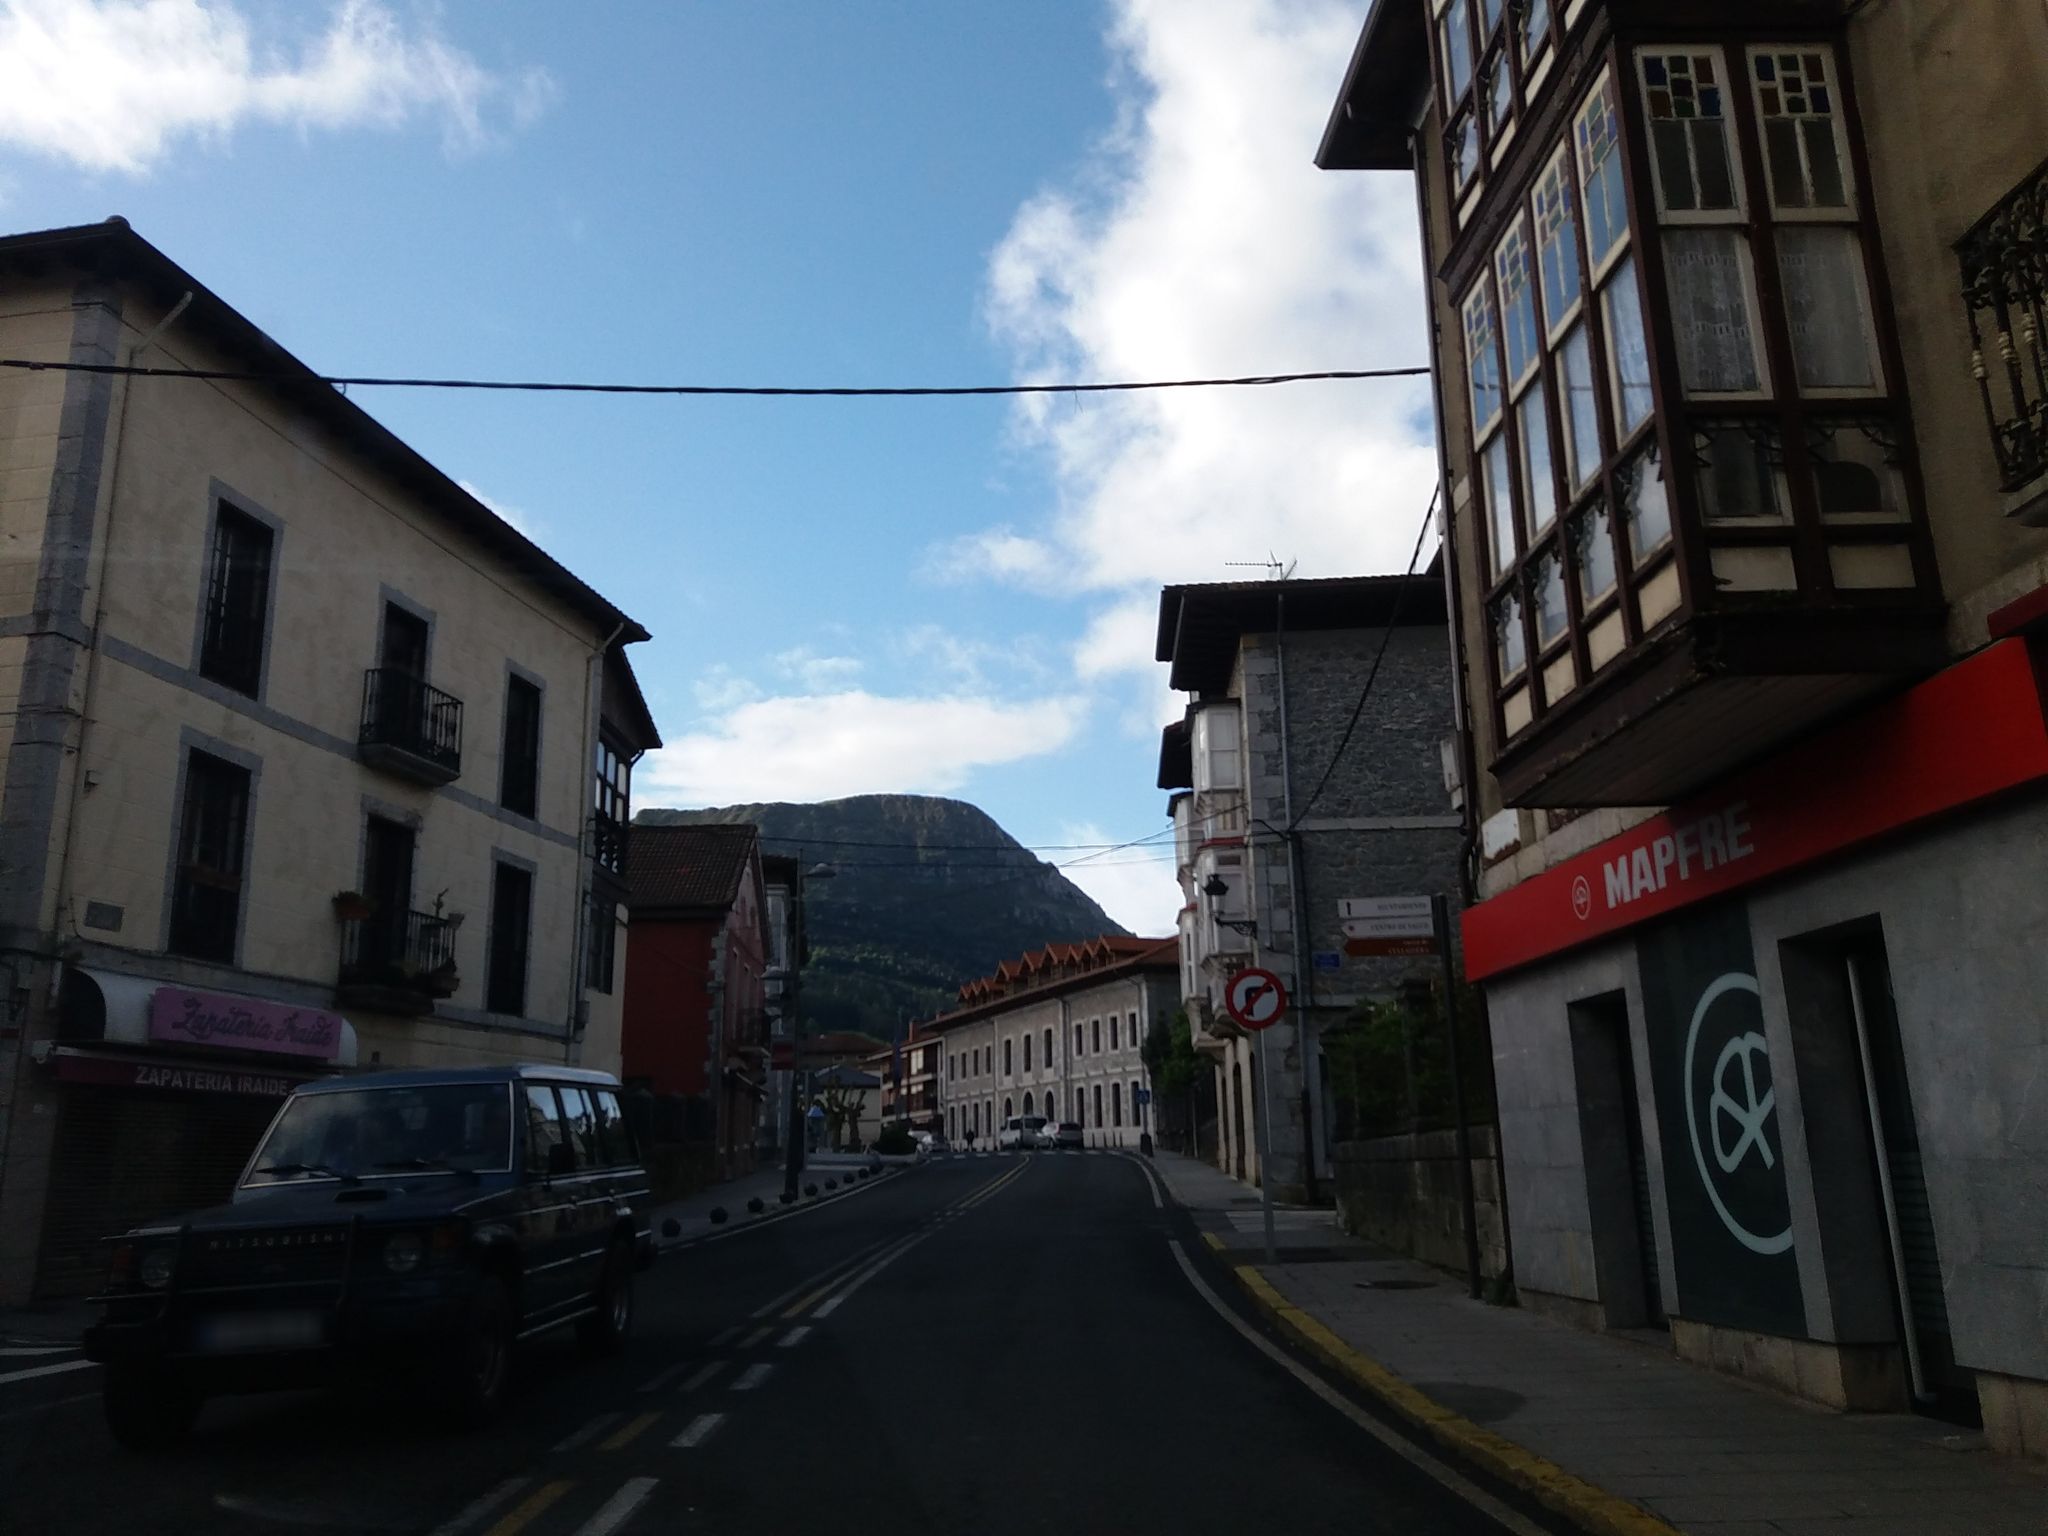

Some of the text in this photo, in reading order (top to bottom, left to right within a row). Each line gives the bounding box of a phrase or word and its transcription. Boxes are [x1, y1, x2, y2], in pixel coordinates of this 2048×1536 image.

[1603, 801, 1754, 909] MAPFRE
[135, 1065, 288, 1096] ZAPATERIA IRAIDE
